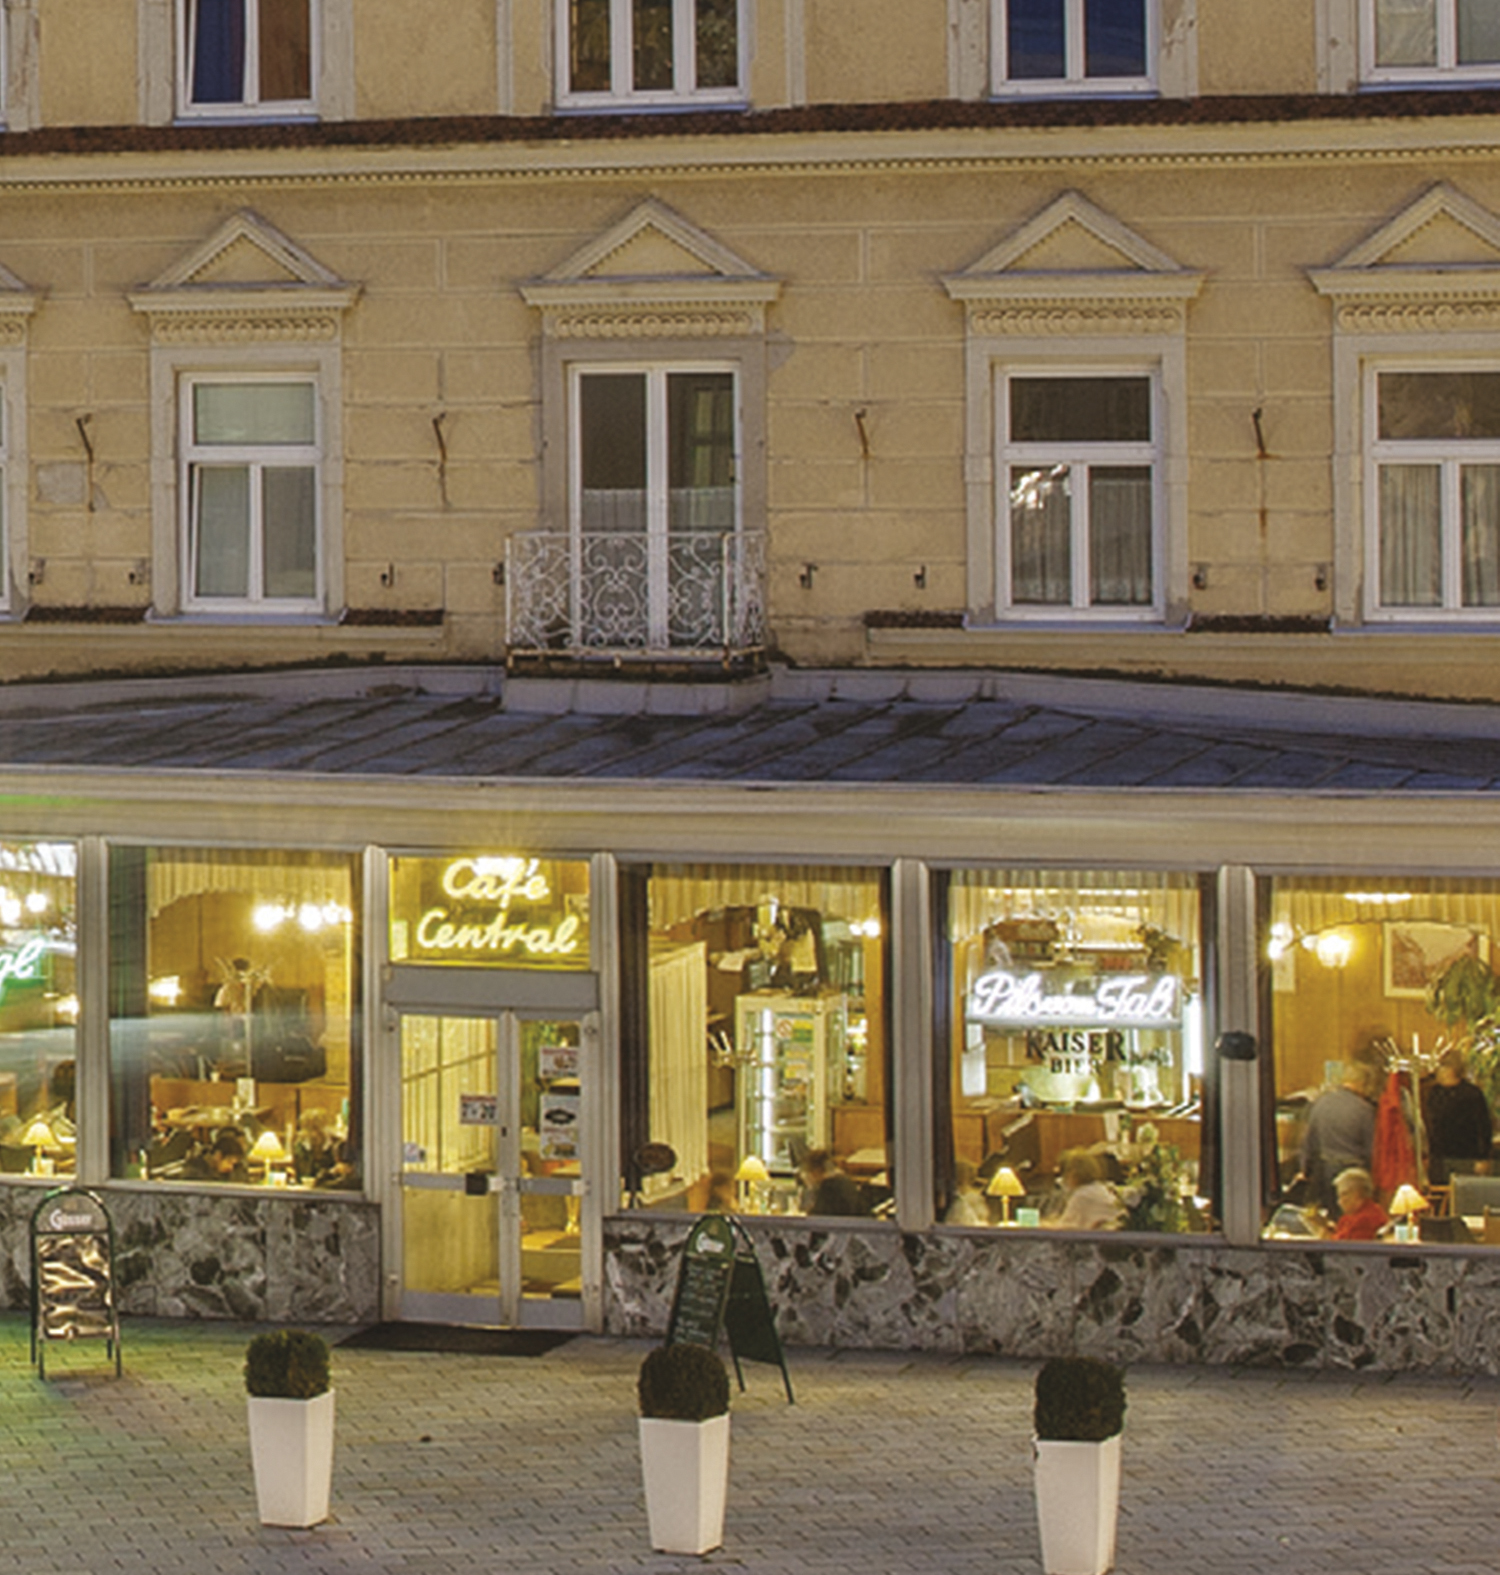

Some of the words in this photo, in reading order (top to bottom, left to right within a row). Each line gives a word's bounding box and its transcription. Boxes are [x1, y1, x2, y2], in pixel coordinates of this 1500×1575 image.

[443, 857, 550, 909] Café
[417, 910, 579, 954] Central
[1026, 1028, 1126, 1063] KAISER
[1050, 1057, 1101, 1076] BIER
